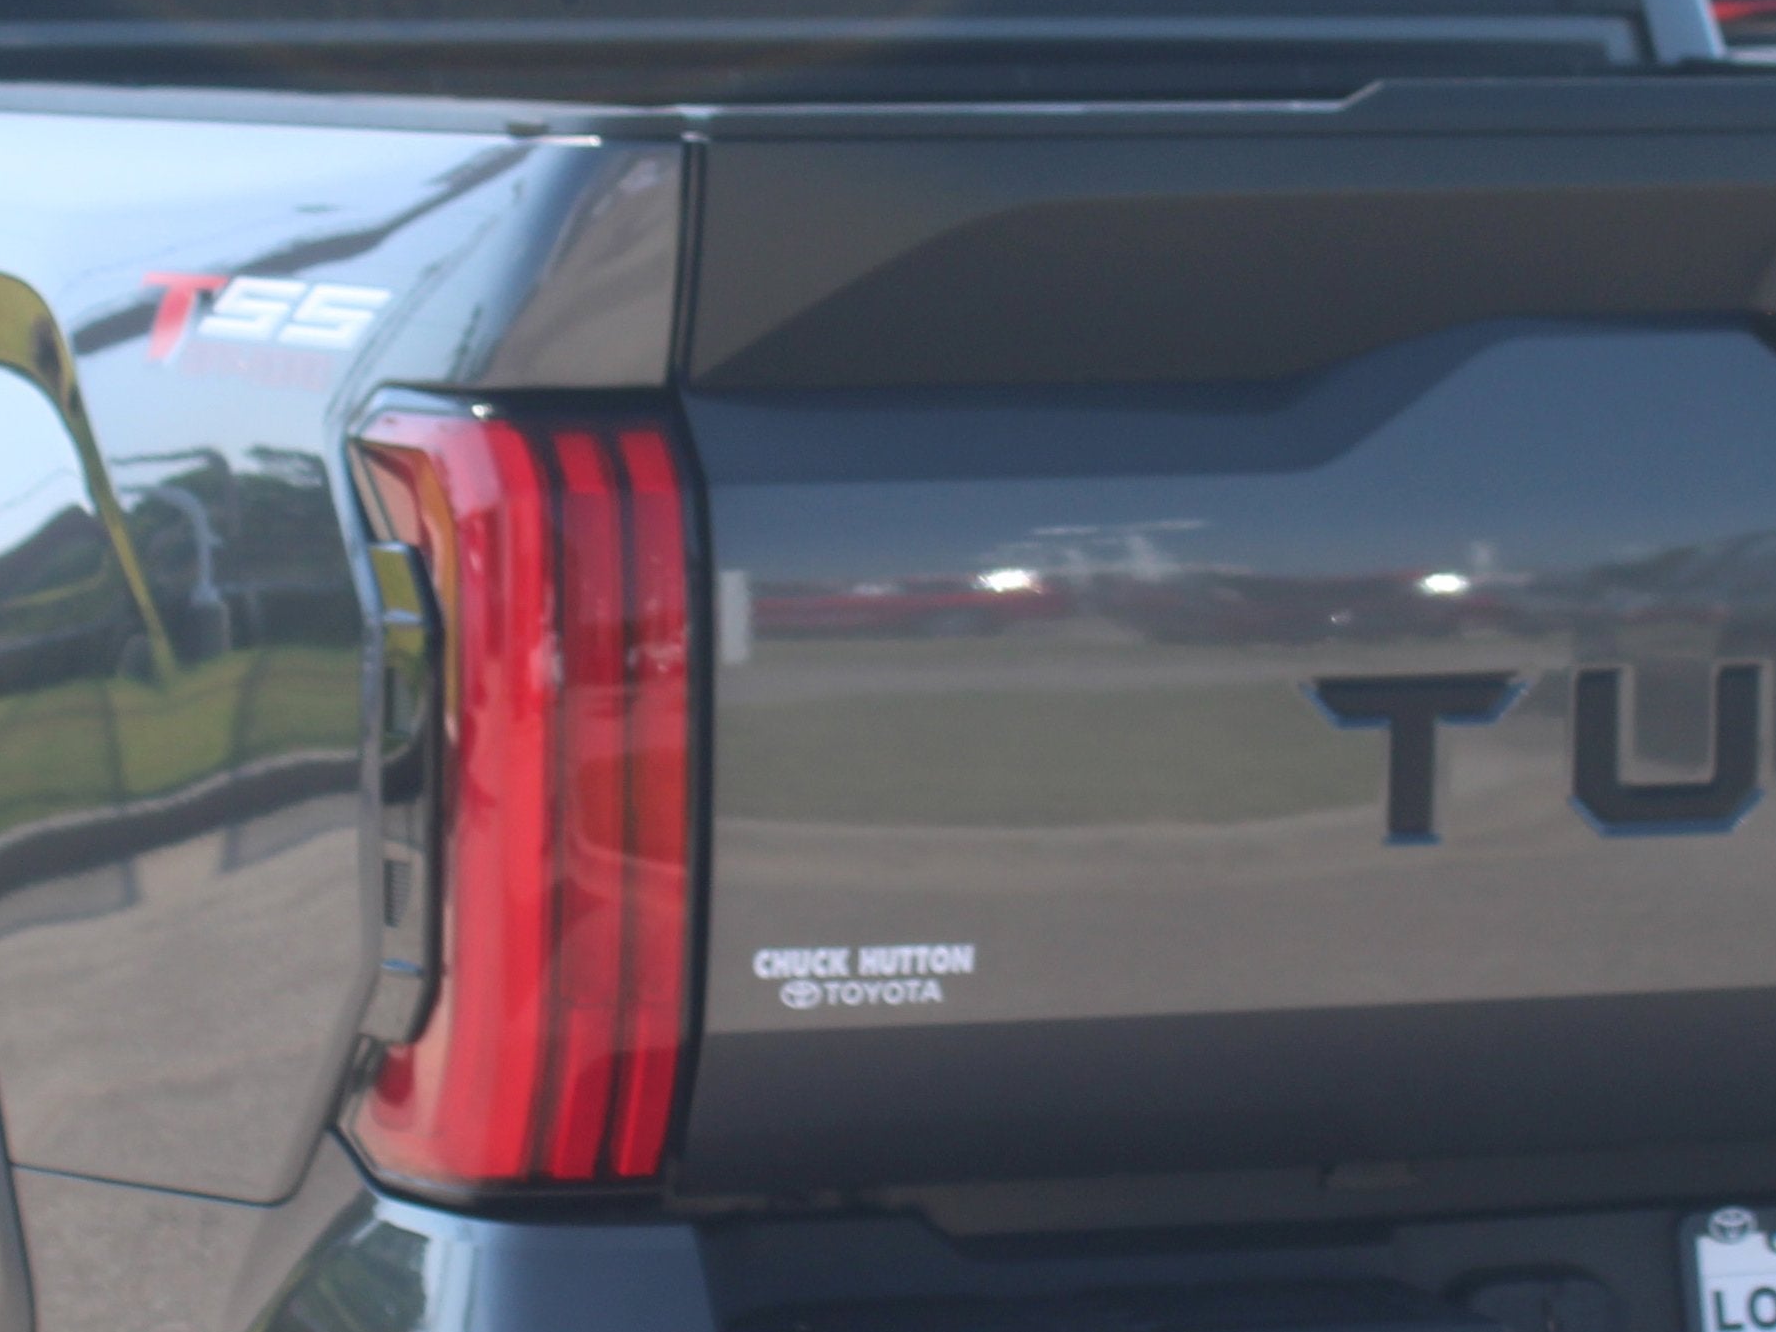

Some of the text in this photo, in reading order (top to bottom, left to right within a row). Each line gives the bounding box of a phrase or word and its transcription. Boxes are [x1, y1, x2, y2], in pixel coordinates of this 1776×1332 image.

[753, 944, 975, 978] CHUCK HUTTON
[824, 979, 942, 1006] TOYOTA
